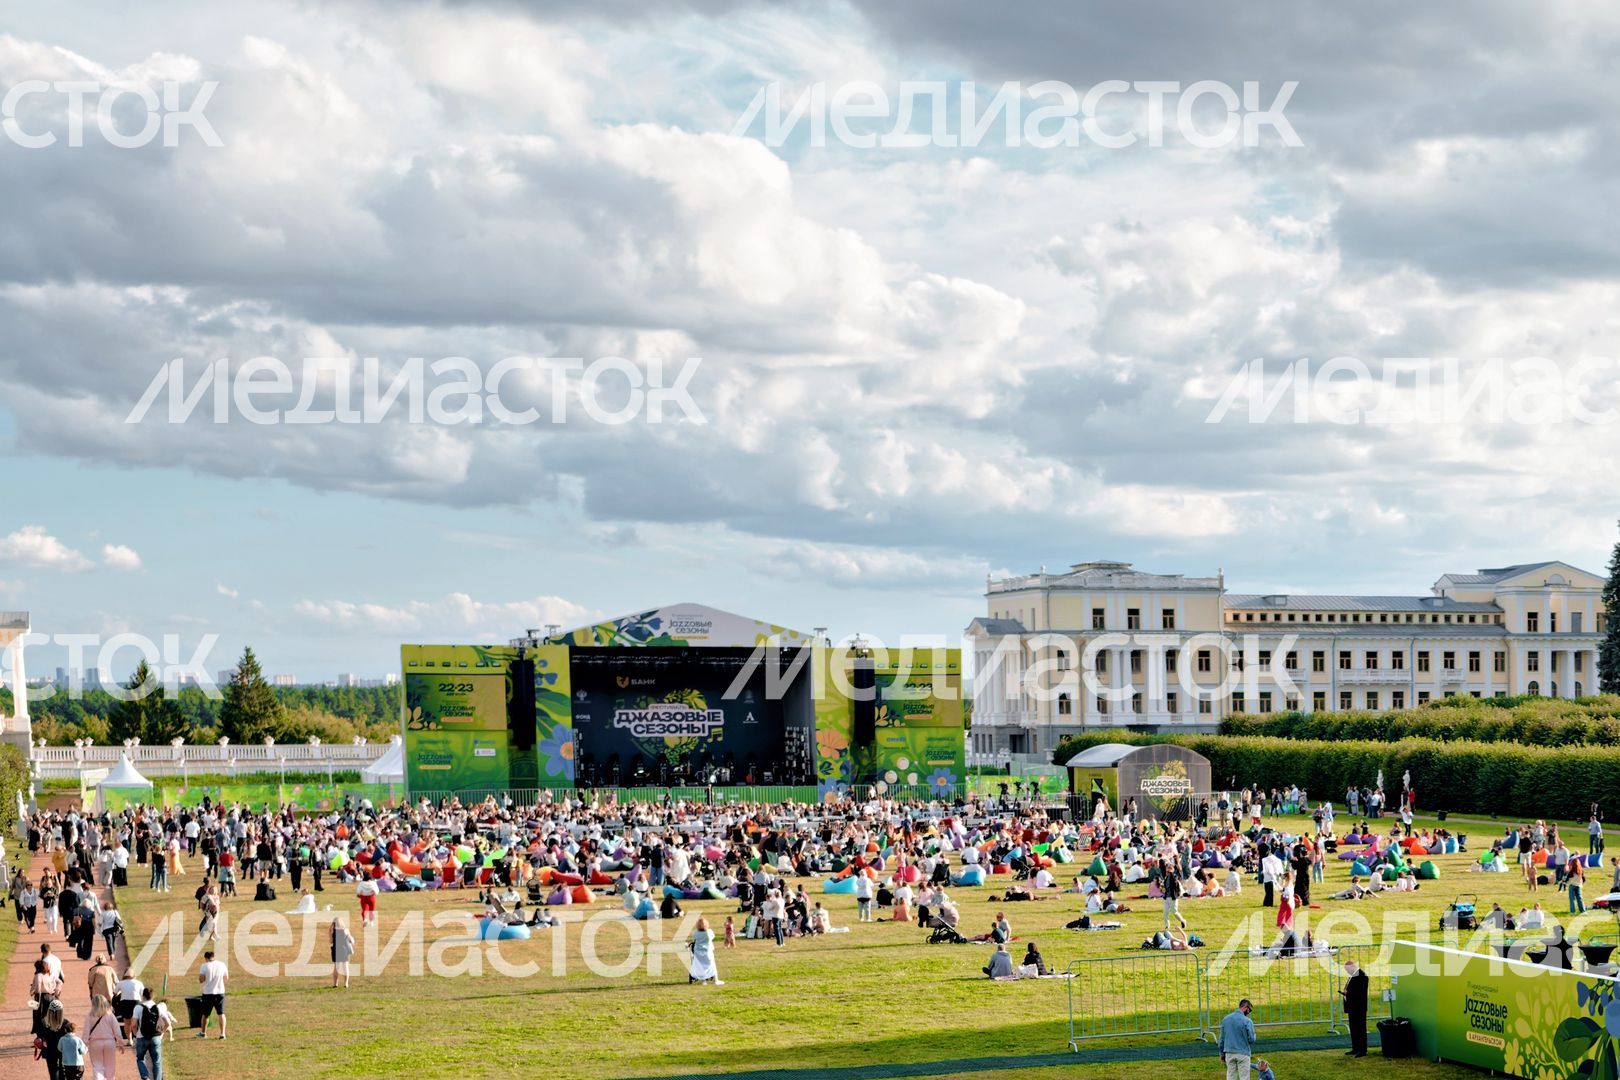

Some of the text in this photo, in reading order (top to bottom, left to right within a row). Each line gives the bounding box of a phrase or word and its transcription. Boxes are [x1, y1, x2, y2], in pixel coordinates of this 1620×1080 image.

[616, 711, 722, 724] ДЖАЗОВЫЕ
[633, 723, 707, 735] СЕЗОНЫ
[1142, 780, 1190, 788] ДЖАЗОВЫЕ
[1464, 994, 1508, 1019] Jazzовые
[1470, 1013, 1504, 1034] сезоны
